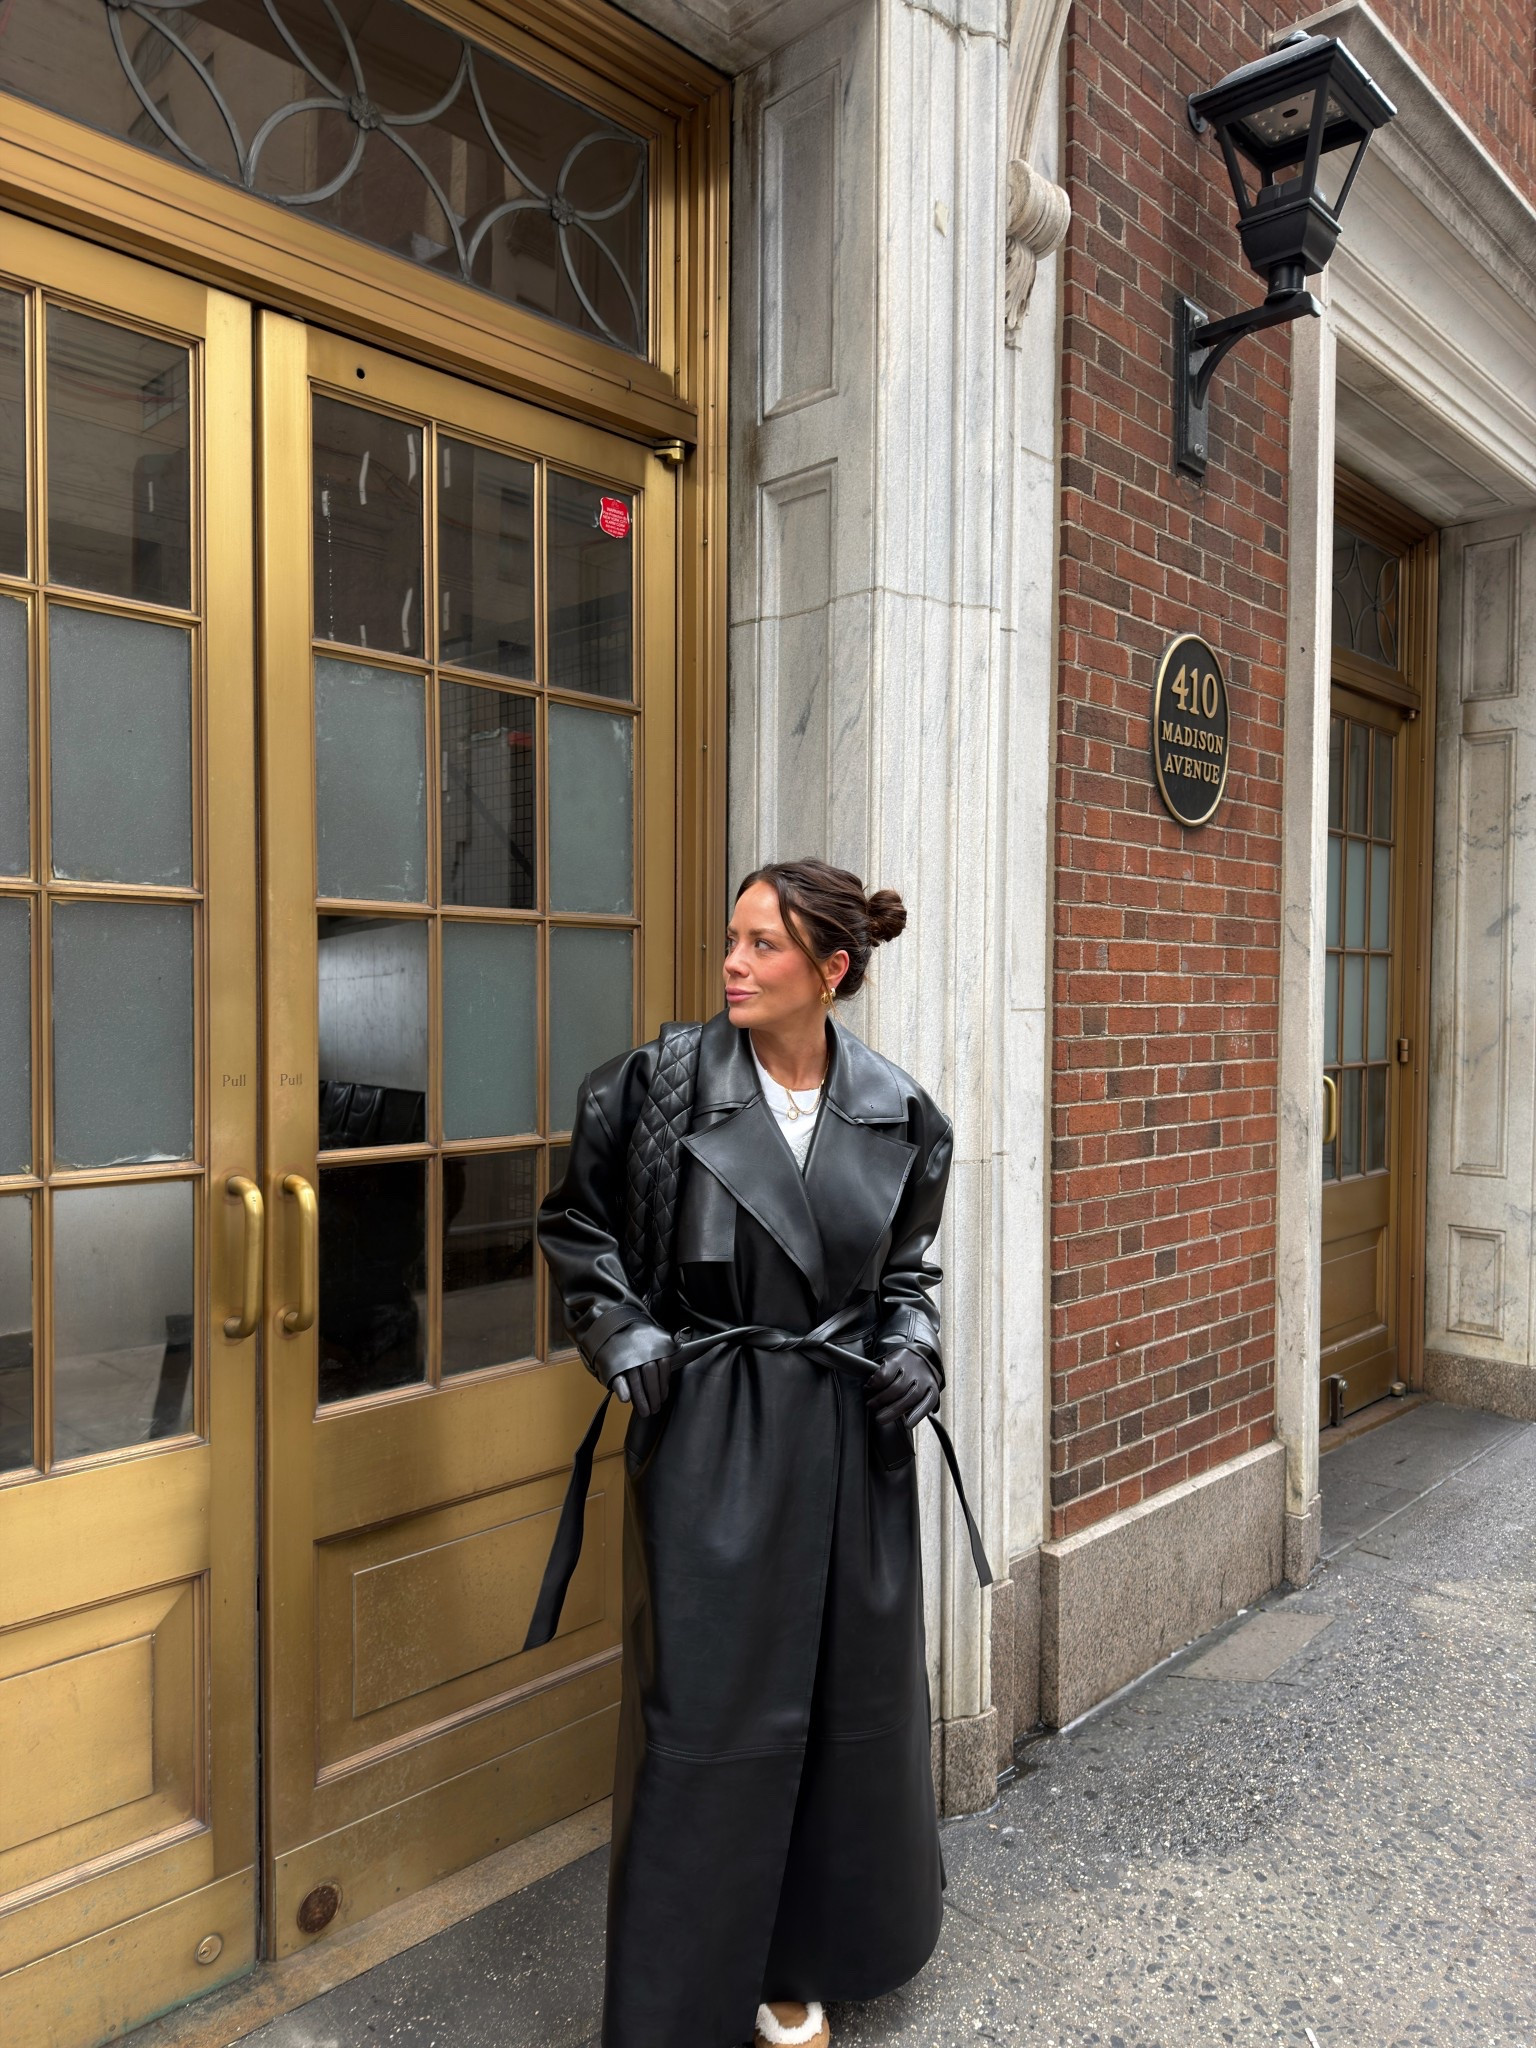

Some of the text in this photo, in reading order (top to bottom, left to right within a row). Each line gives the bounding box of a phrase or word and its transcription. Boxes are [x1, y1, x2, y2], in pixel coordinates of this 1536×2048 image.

[1171, 664, 1218, 719] 410
[1161, 720, 1224, 755] MADISON
[1163, 753, 1220, 785] AVENUE
[222, 1074, 246, 1087] Pull
[280, 1073, 302, 1086] Pull
